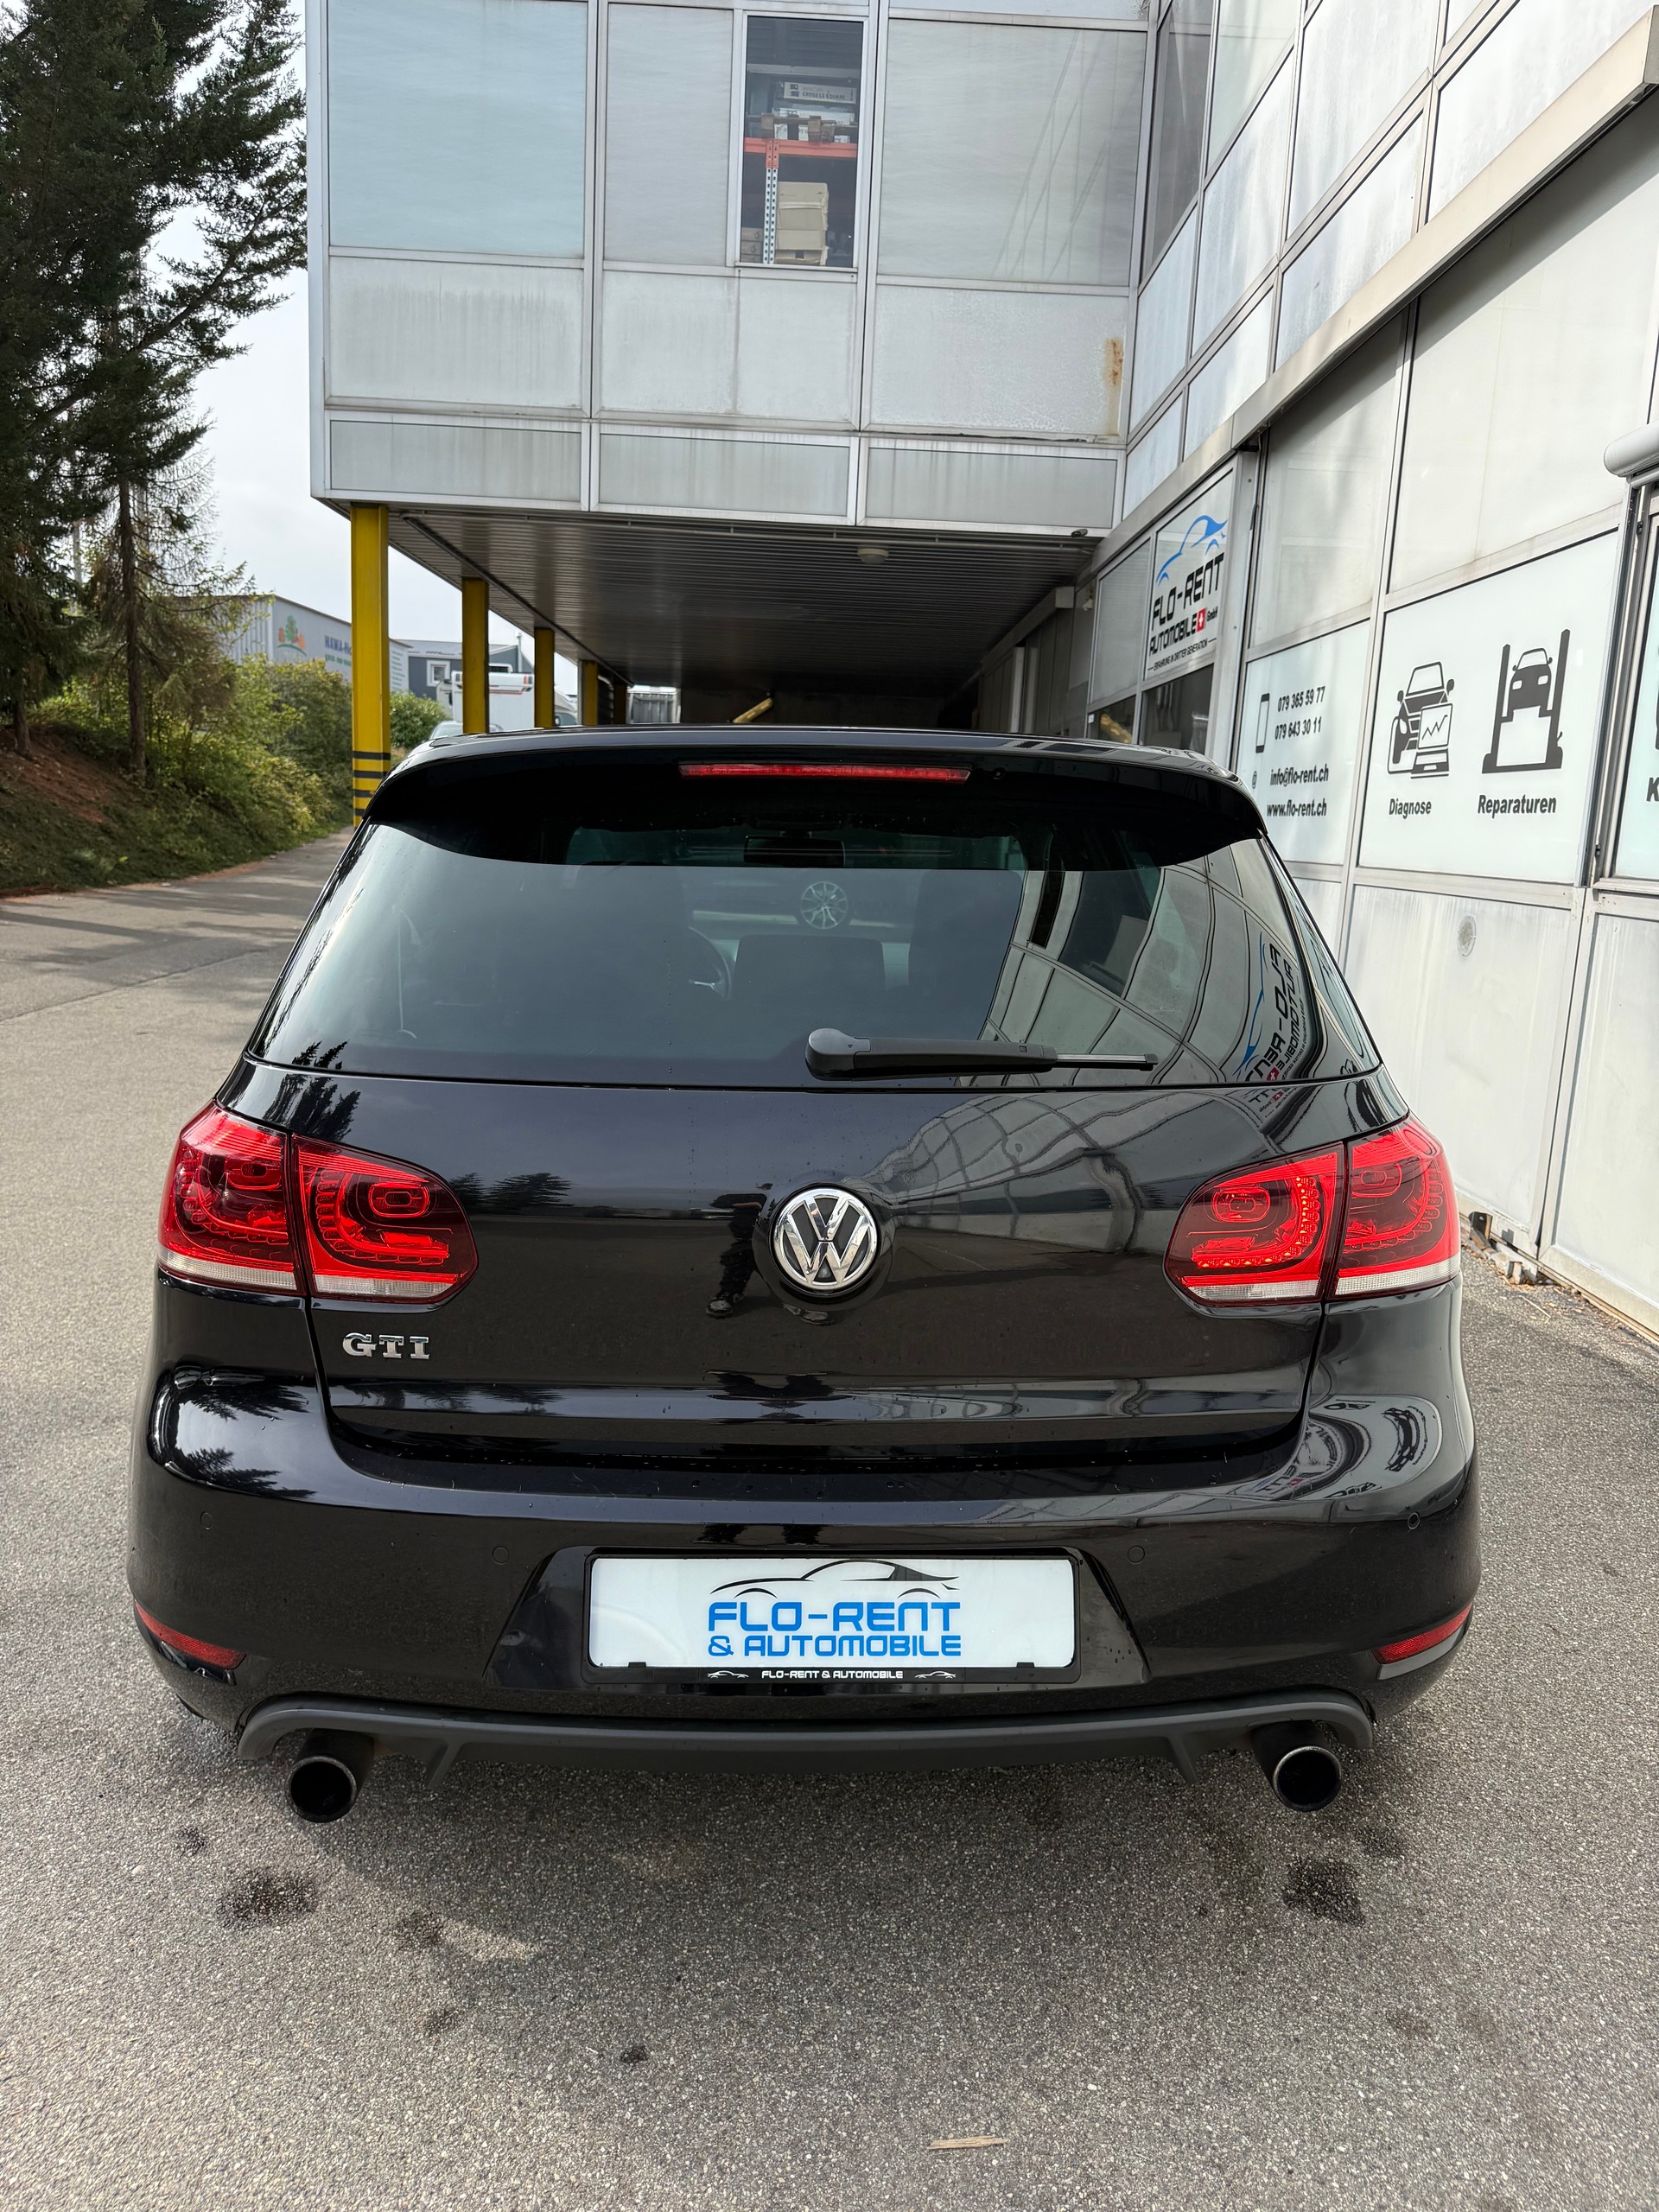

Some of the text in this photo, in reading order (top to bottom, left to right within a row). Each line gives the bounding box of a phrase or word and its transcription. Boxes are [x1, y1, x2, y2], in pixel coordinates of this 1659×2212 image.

[1151, 552, 1224, 631] FLO-RENT
[1149, 613, 1198, 657] AUTOMOBILE
[1277, 685, 1325, 712] 079 365 59 77
[1274, 716, 1322, 741] 079 643 30 11
[1270, 763, 1329, 786] info@flo-rent.ch
[1267, 798, 1327, 817] www.flo-rent.ch
[1389, 798, 1432, 819] Diagnose
[1478, 794, 1556, 819] Reparaturen
[776, 1190, 876, 1288] VW
[342, 1332, 430, 1359] GTI
[708, 1601, 961, 1632] FLO-RENT
[708, 1635, 962, 1656] & AUTOMOBILE
[761, 1669, 904, 1680] FLO-RENT & AUTOMOBILE
